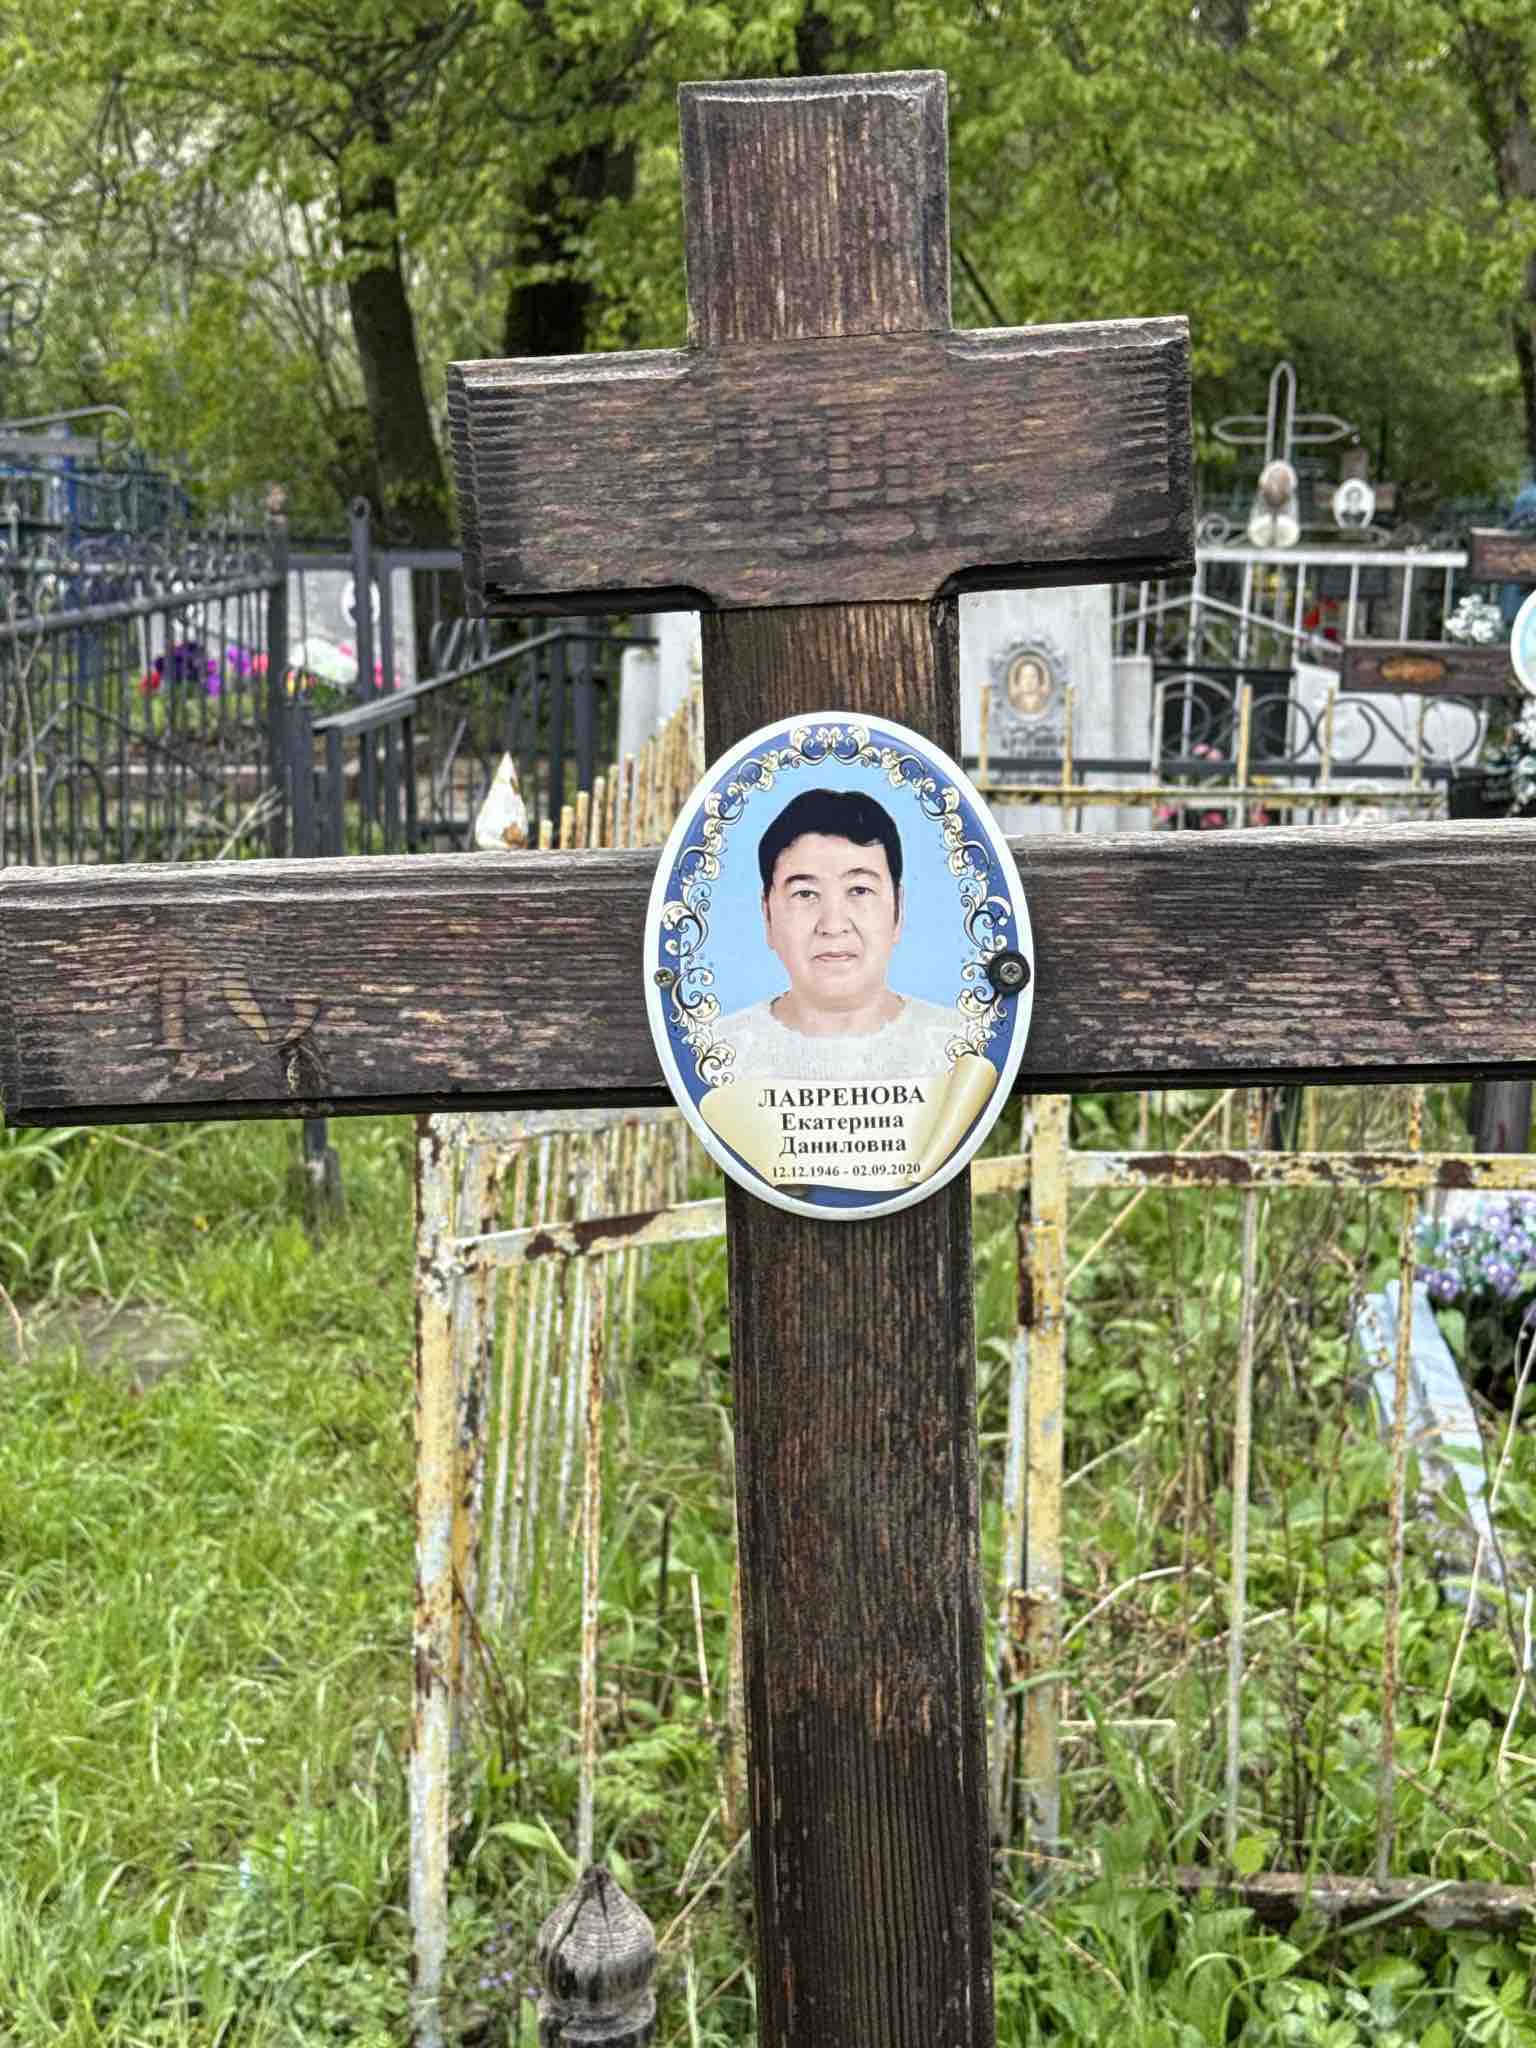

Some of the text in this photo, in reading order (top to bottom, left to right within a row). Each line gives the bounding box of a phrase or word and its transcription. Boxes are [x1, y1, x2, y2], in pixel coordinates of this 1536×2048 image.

[758, 1085, 926, 1108] ЛАВРЕНОВА
[781, 1112, 904, 1134] Екатерина
[778, 1136, 906, 1158] Даниловна
[772, 1165, 840, 1178] 12.12.1946
[852, 1162, 921, 1177] 02.09.2020
